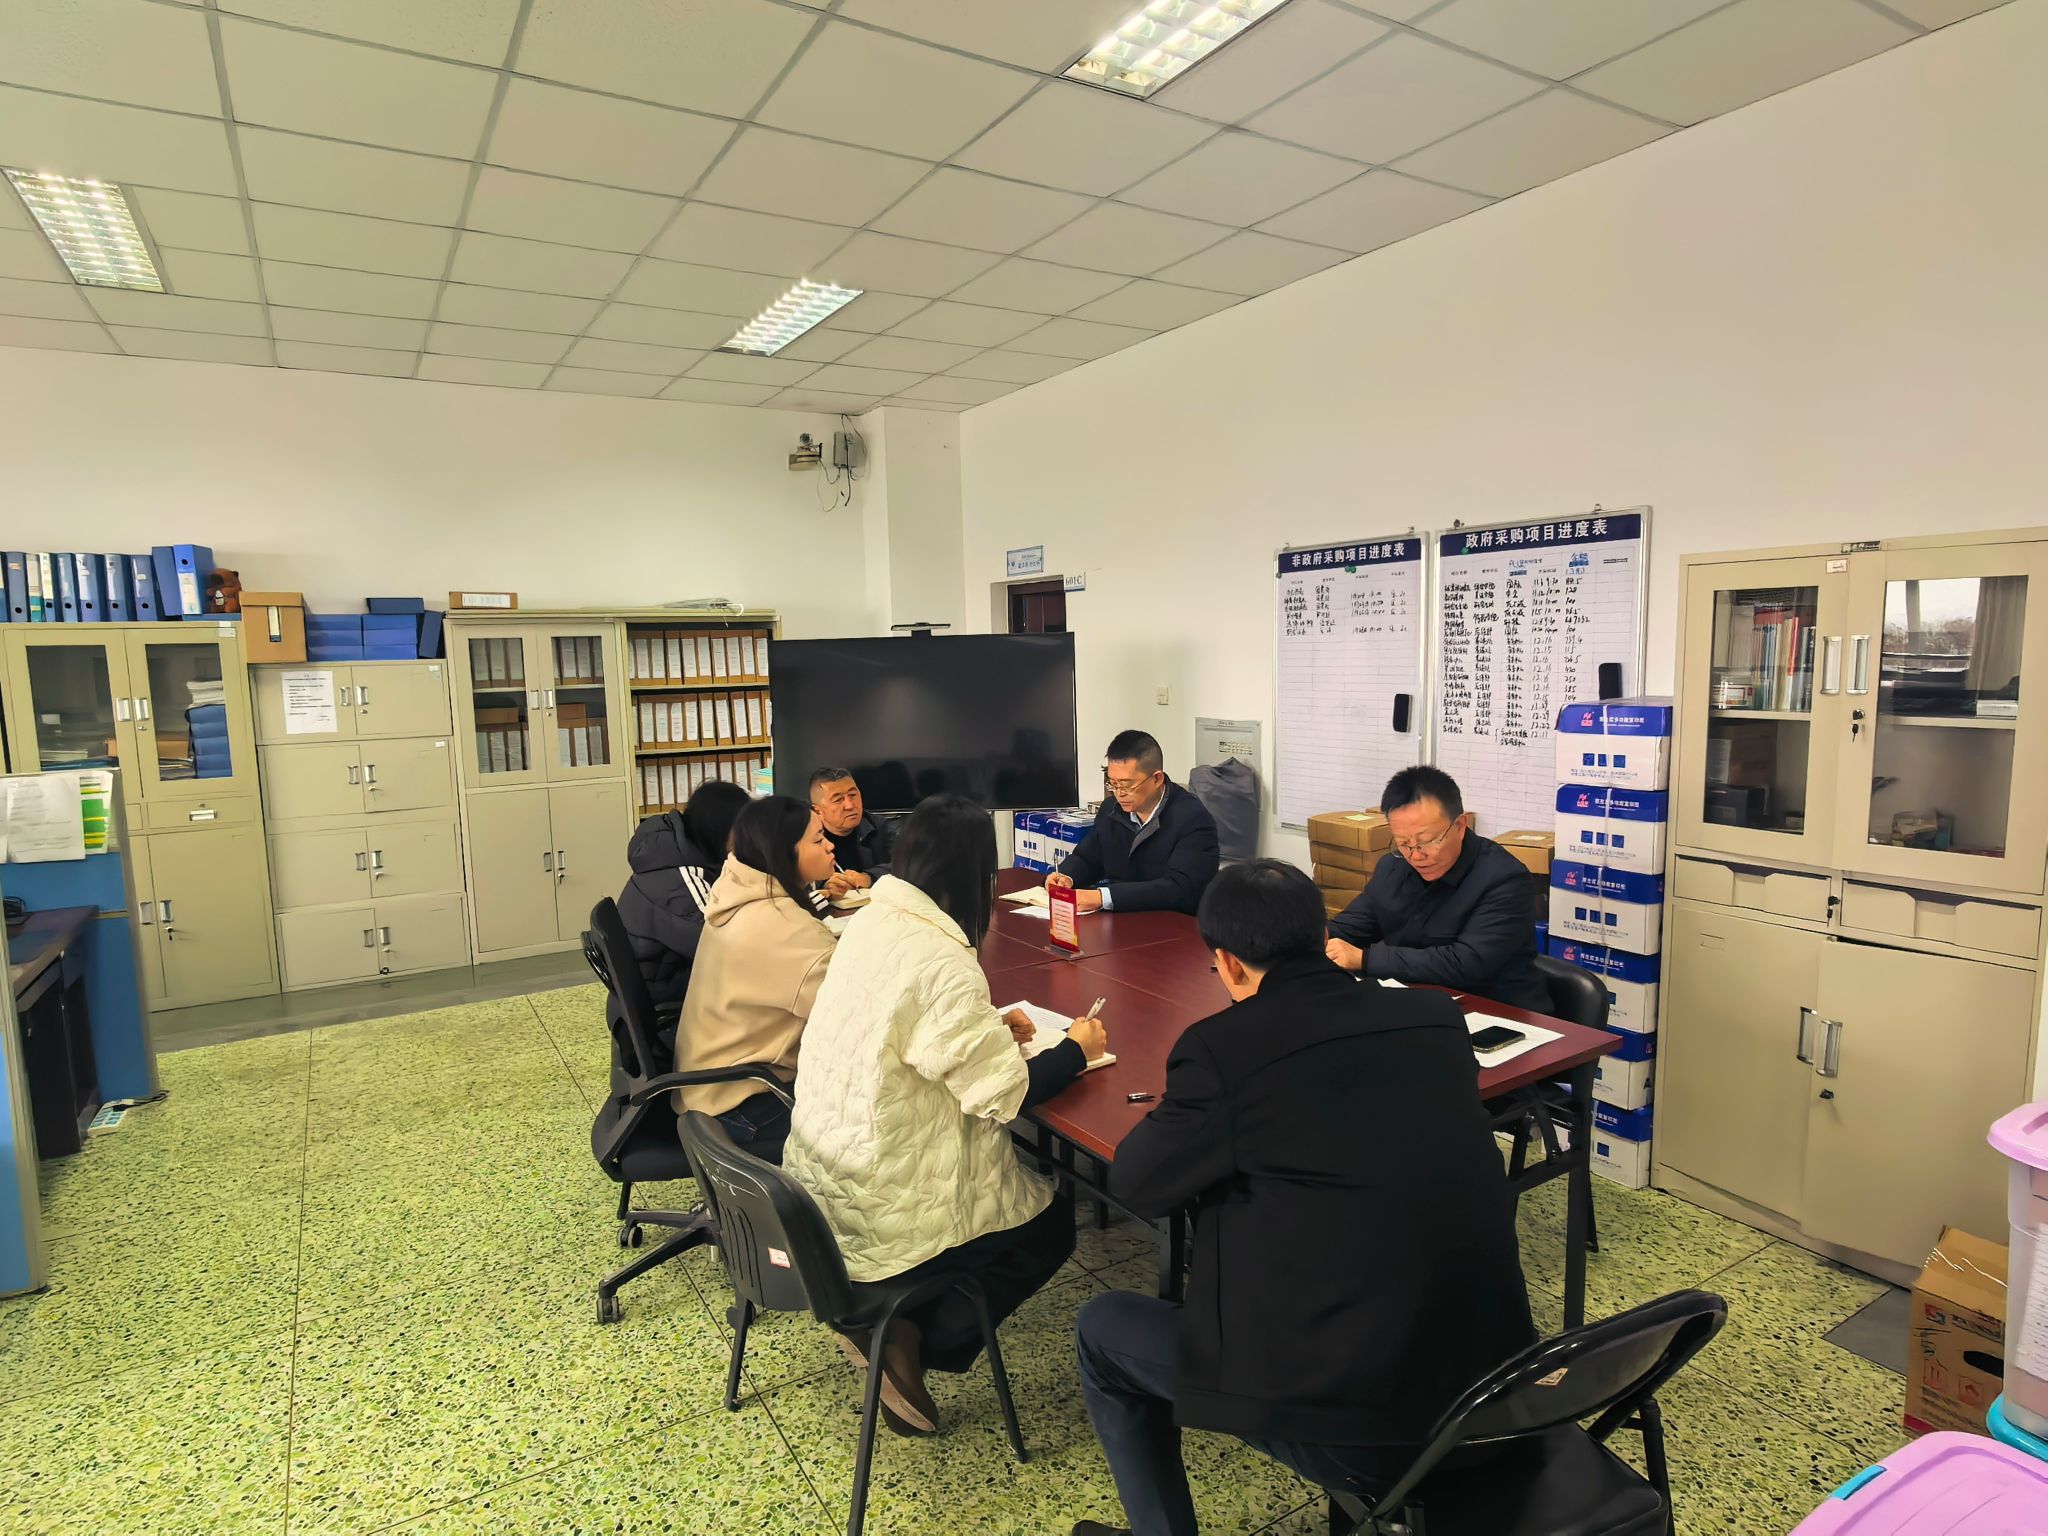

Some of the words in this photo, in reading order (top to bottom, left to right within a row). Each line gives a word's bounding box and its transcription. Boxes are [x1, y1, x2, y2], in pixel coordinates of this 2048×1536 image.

[1465, 518, 1608, 549] 政府采购项目进度表
[1291, 542, 1405, 568] 非政府采购项目进度表
